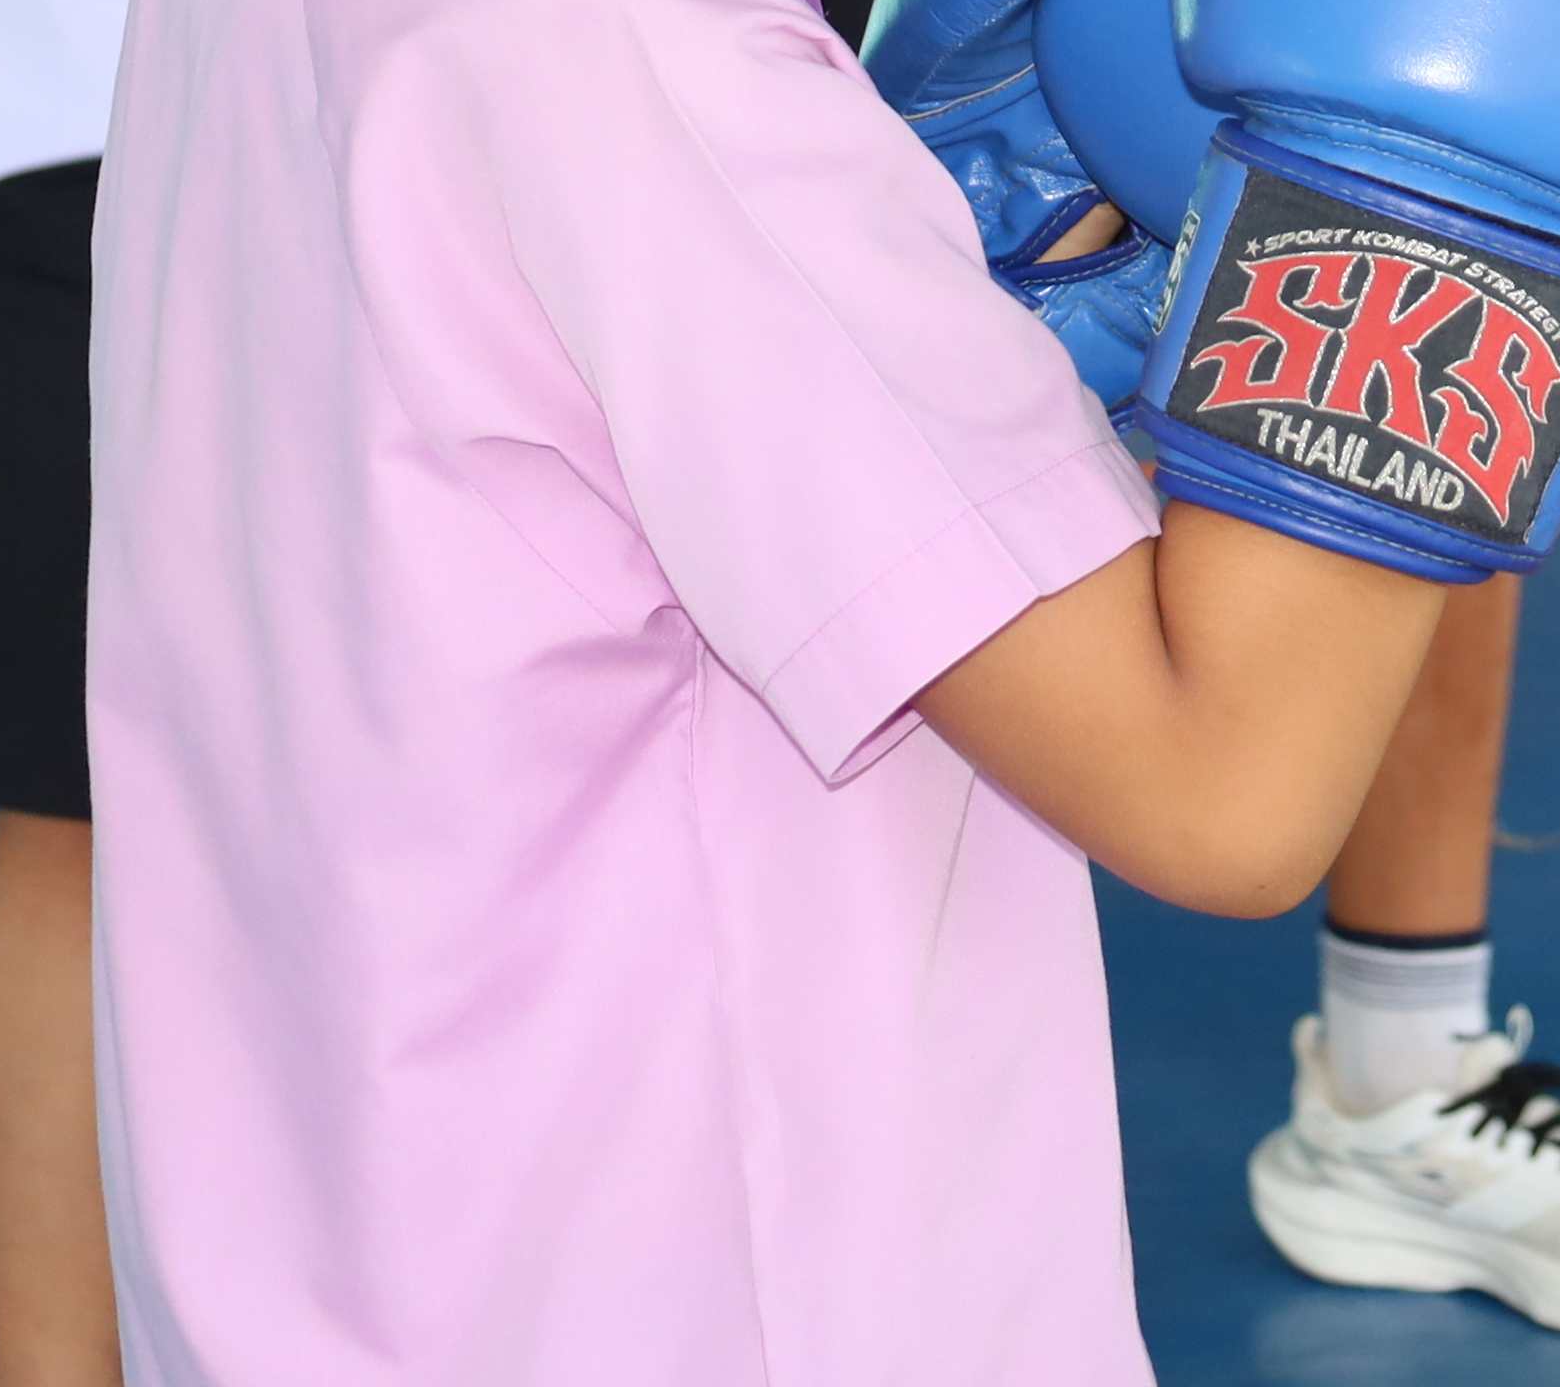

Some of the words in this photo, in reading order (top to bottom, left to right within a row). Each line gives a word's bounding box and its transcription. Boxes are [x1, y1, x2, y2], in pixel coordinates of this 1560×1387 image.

[1263, 228, 1351, 253] SPORT
[1352, 229, 1468, 267] KOMBAT
[1256, 408, 1466, 513] THAILAND
